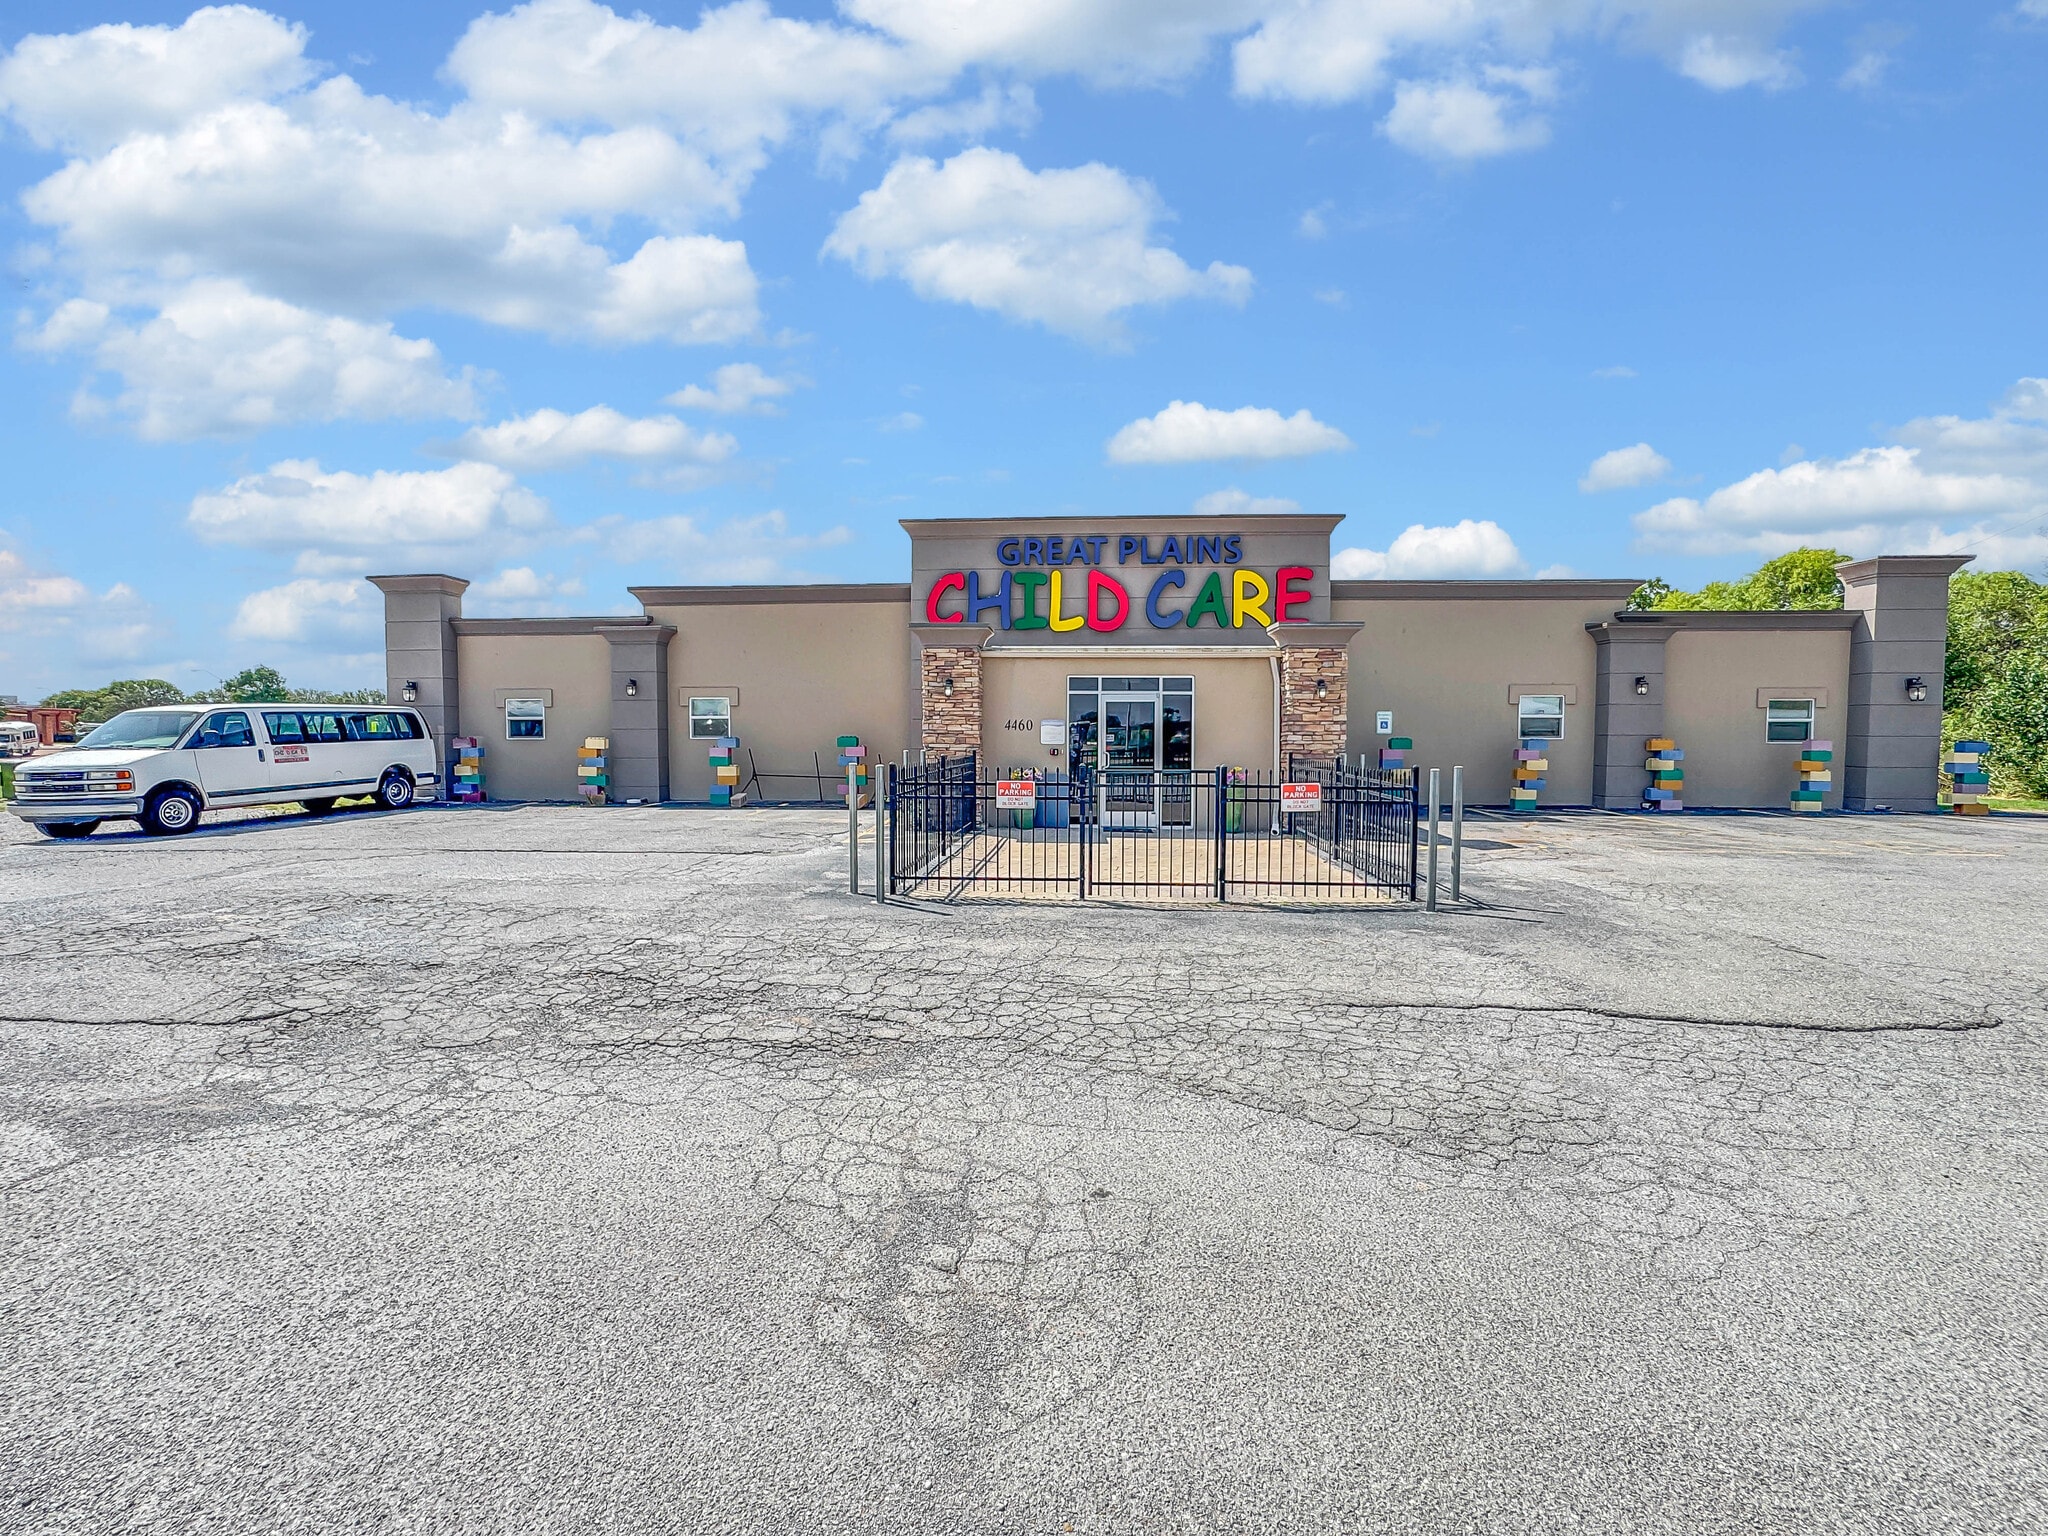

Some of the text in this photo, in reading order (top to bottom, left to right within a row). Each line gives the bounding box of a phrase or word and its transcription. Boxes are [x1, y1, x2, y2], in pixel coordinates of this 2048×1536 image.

[997, 535, 1243, 566] GREAT PLAINS
[926, 566, 1314, 632] CHILD CARE
[1004, 719, 1033, 731] 4460
[1010, 782, 1021, 790] NO
